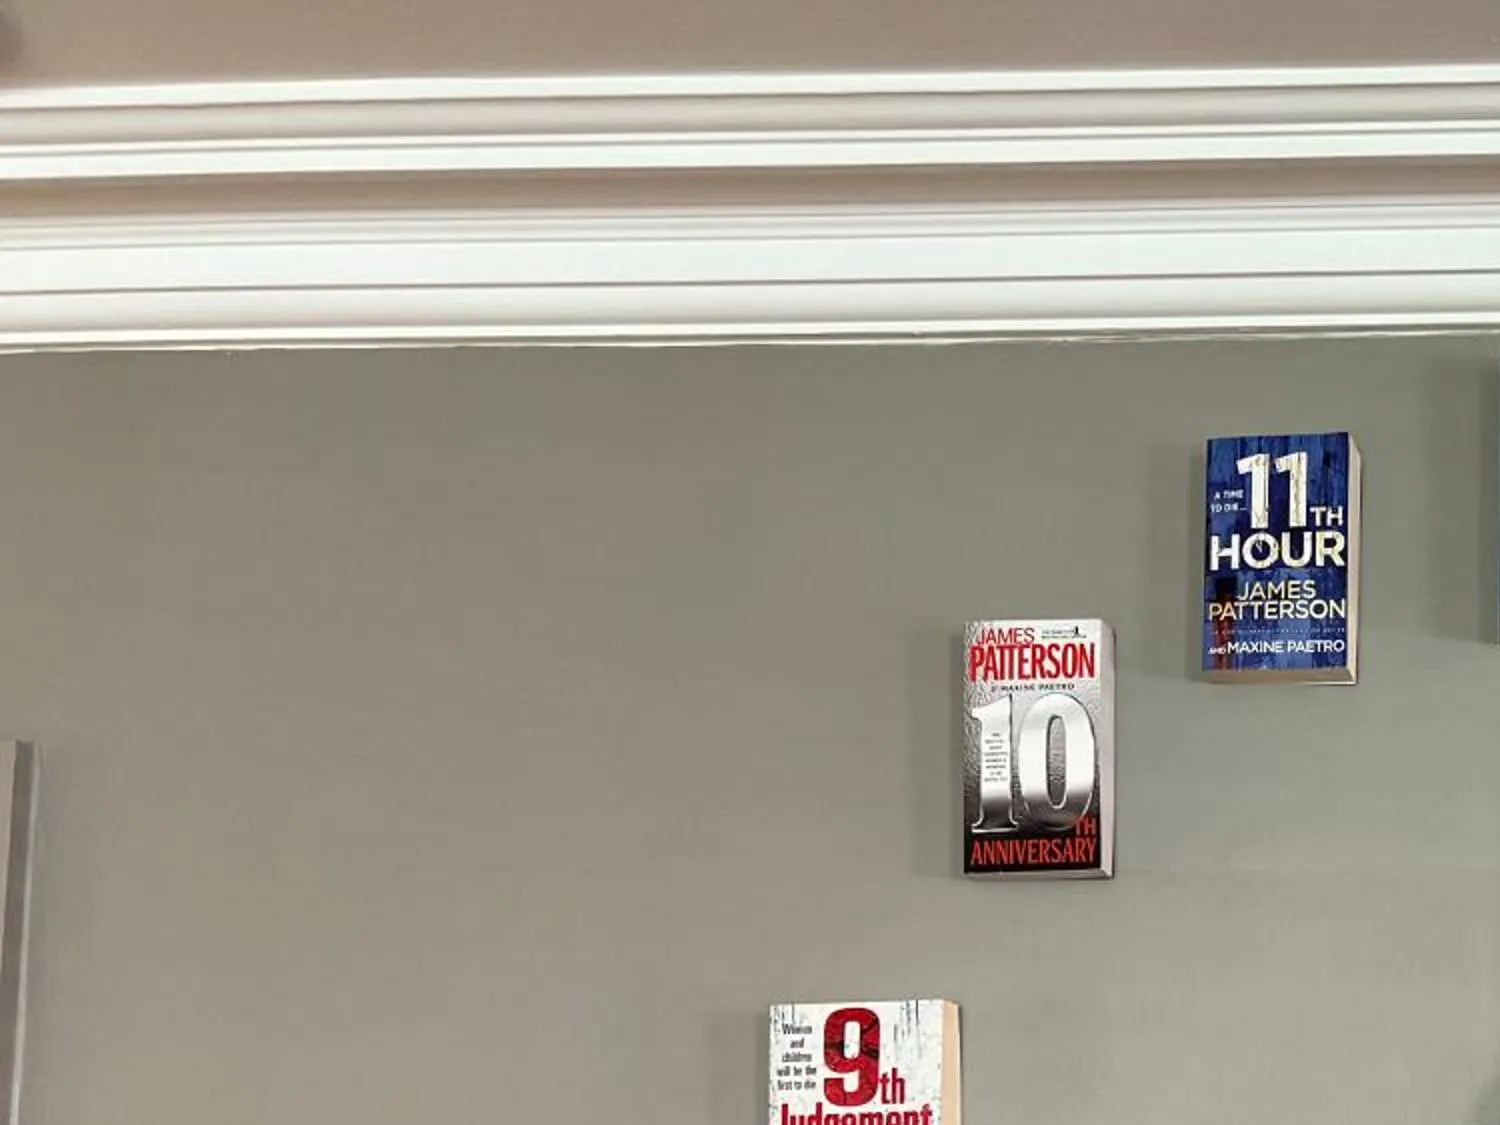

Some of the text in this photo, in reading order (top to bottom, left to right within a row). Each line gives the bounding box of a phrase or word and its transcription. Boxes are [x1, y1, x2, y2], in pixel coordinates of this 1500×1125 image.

[1209, 531, 1345, 571] HOUR
[1237, 579, 1317, 600] JAMES
[1209, 599, 1345, 620] PATTERSON
[976, 627, 1035, 645] JAMES
[1227, 640, 1284, 653] MAXINE
[1287, 640, 1345, 653] PAETRO
[970, 642, 1095, 682] PATTERSON
[971, 837, 1096, 865] ANNIVERSARY
[790, 1038, 805, 1049] and
